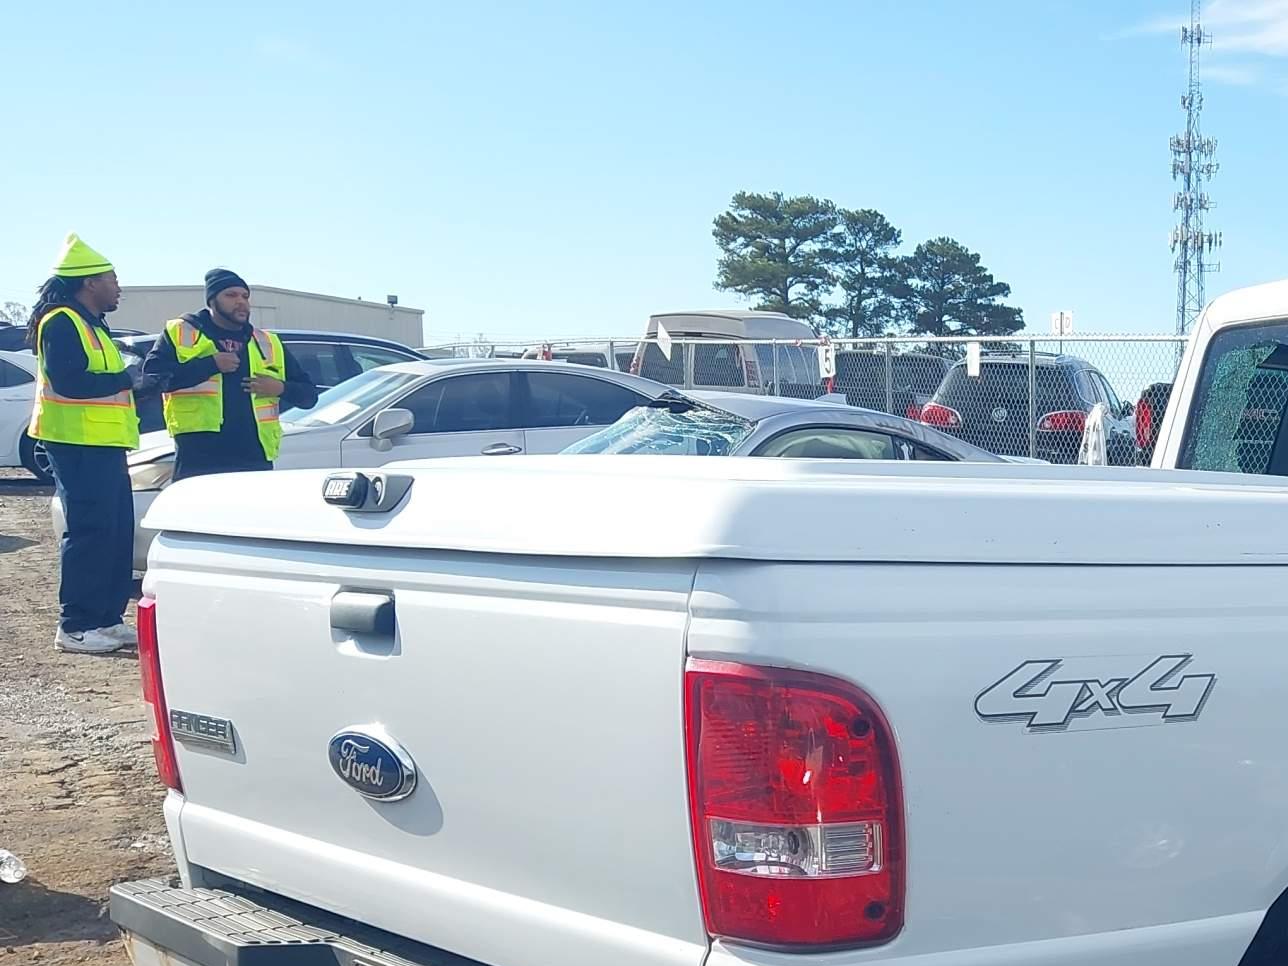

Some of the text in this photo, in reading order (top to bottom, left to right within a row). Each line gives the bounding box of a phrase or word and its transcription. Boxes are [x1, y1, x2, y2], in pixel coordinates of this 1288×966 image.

[824, 348, 832, 375] 5
[973, 653, 1217, 734] 4x4
[170, 709, 229, 740] RANGER
[338, 738, 385, 787] Ford
